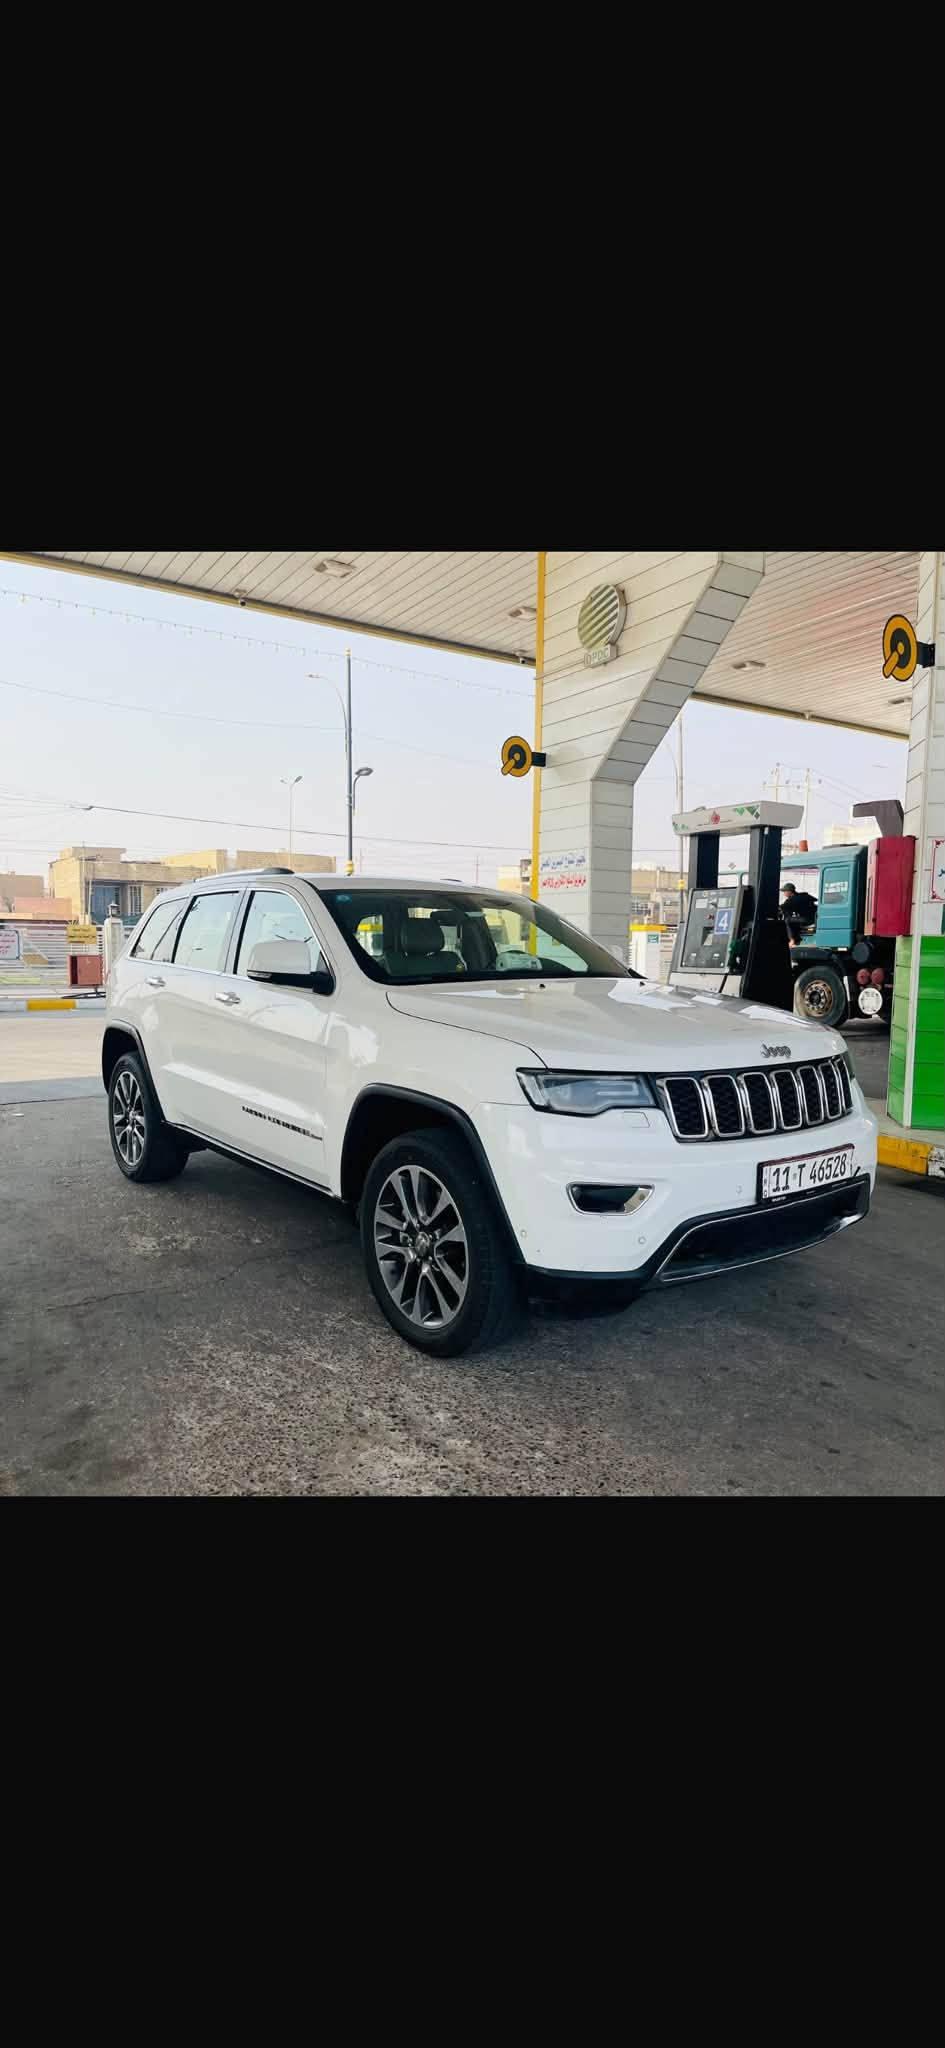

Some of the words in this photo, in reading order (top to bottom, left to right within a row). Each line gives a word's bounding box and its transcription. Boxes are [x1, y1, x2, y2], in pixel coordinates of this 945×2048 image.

[718, 911, 728, 931] 4
[761, 1043, 791, 1059] Jeep
[772, 1166, 790, 1192] 11
[797, 1163, 807, 1187] T
[809, 1153, 847, 1184] 46528
